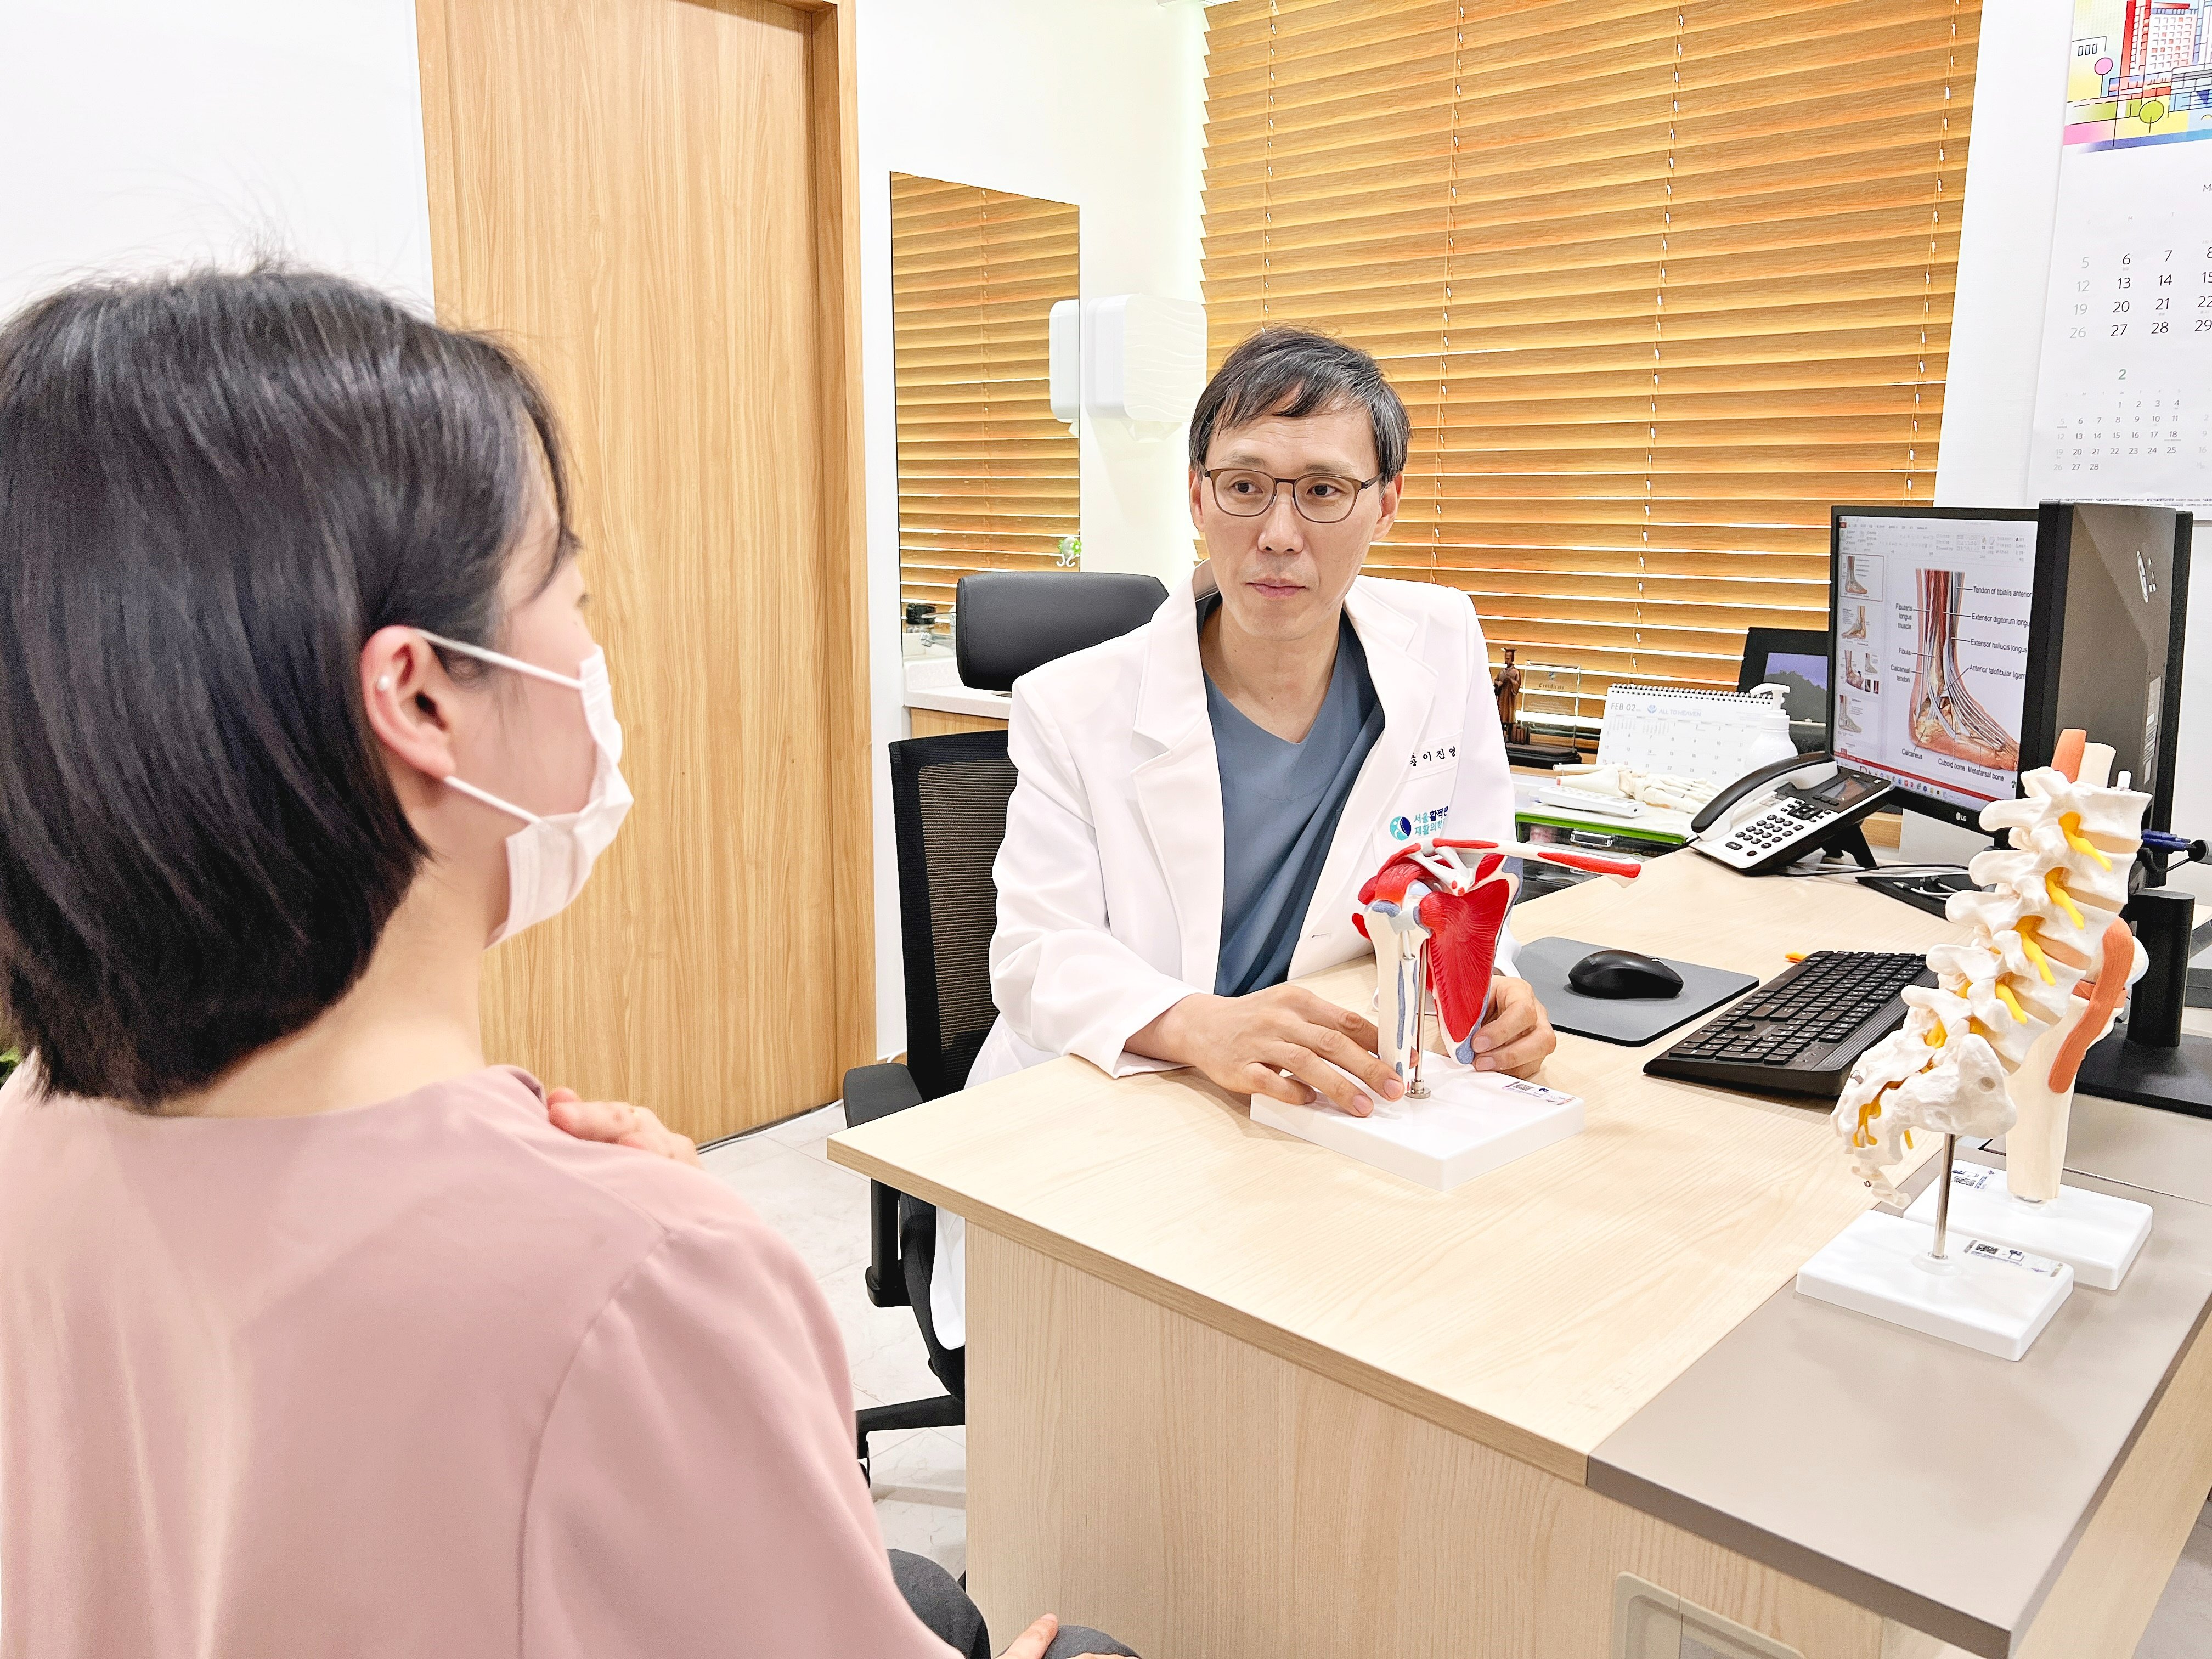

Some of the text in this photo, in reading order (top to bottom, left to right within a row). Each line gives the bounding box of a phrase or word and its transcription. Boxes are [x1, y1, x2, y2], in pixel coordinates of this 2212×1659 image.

[2081, 256, 2090, 268] 5
[2122, 253, 2131, 265] 6
[2164, 250, 2172, 262] 7
[2076, 280, 2090, 292] 12
[2118, 277, 2131, 289] 13
[2158, 274, 2172, 286] 14
[2073, 295, 2212, 315] 19 20 21 22
[2069, 319, 2212, 338] 26 27 28 29
[2118, 368, 2126, 380] 2
[1973, 585, 1990, 594] Tendon
[1895, 603, 1912, 612] Fibularis
[1899, 613, 1912, 621] longus
[1972, 613, 1993, 622] Extensor
[1993, 616, 2016, 625] digitorum
[1898, 647, 1911, 656] Fibula
[1971, 638, 2027, 654] Extensor hallucis longus
[1891, 664, 1910, 674] Calcaneal
[1611, 702, 1624, 711] FEB
[1901, 748, 1923, 760] Calcaneus
[1938, 758, 1965, 771] Cuboid bone
[1967, 766, 2005, 782] Metatarsal bone
